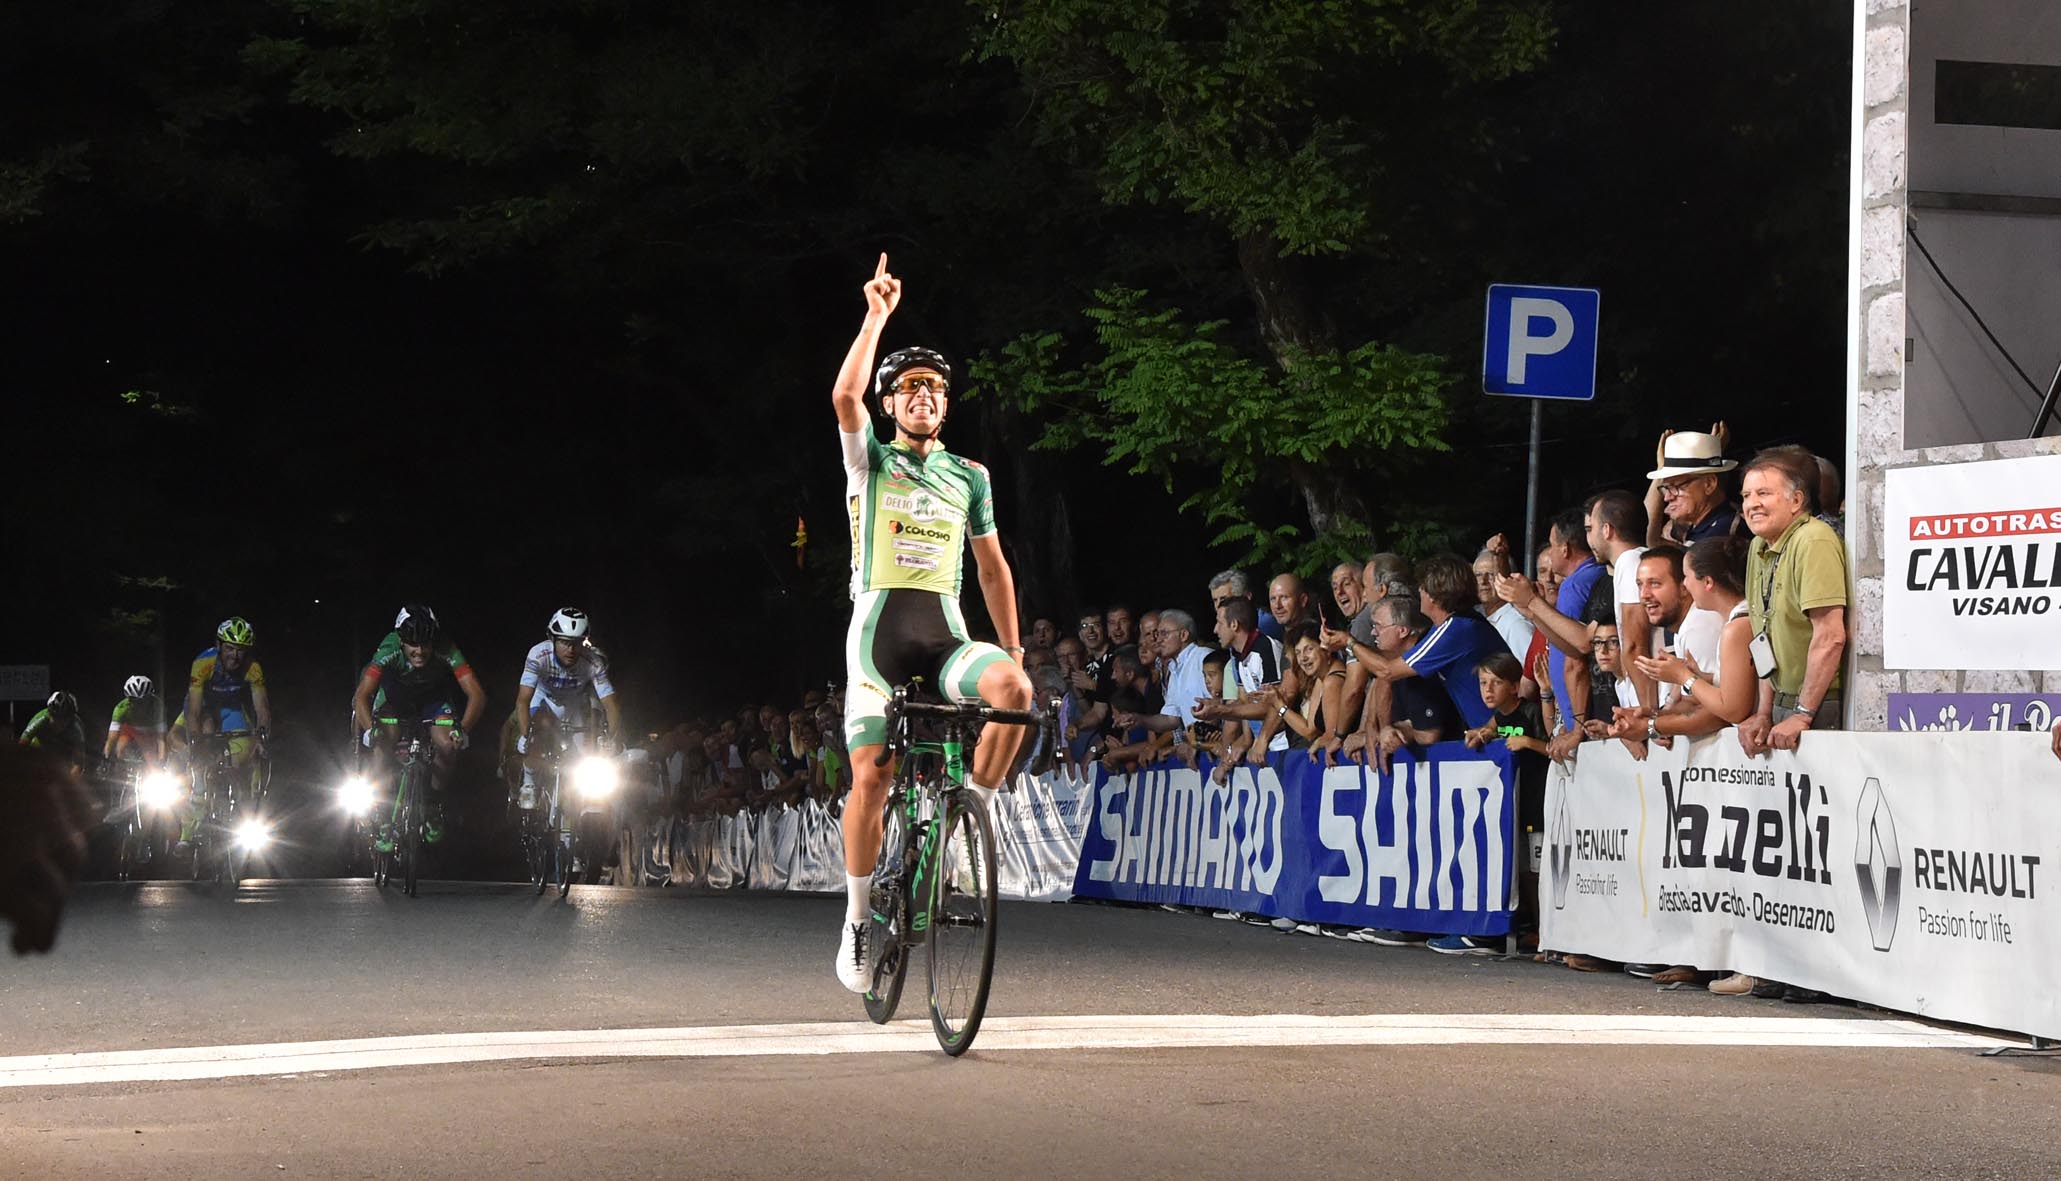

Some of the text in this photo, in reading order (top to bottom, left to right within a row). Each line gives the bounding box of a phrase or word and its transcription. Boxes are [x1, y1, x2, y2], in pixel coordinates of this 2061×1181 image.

[1507, 297, 1574, 384] P
[905, 525, 951, 542] COLOSIO
[1913, 511, 2061, 538] AUTOTRAS
[1952, 595, 2052, 617] VISANO
[1089, 766, 1284, 896] SHIMANO
[1318, 760, 1504, 912] SHIM
[1576, 829, 1629, 862] RENAULT
[1914, 847, 2041, 899] RENAULT
[1753, 892, 1836, 934] Desenzano
[1918, 905, 2012, 944] Passion for life
